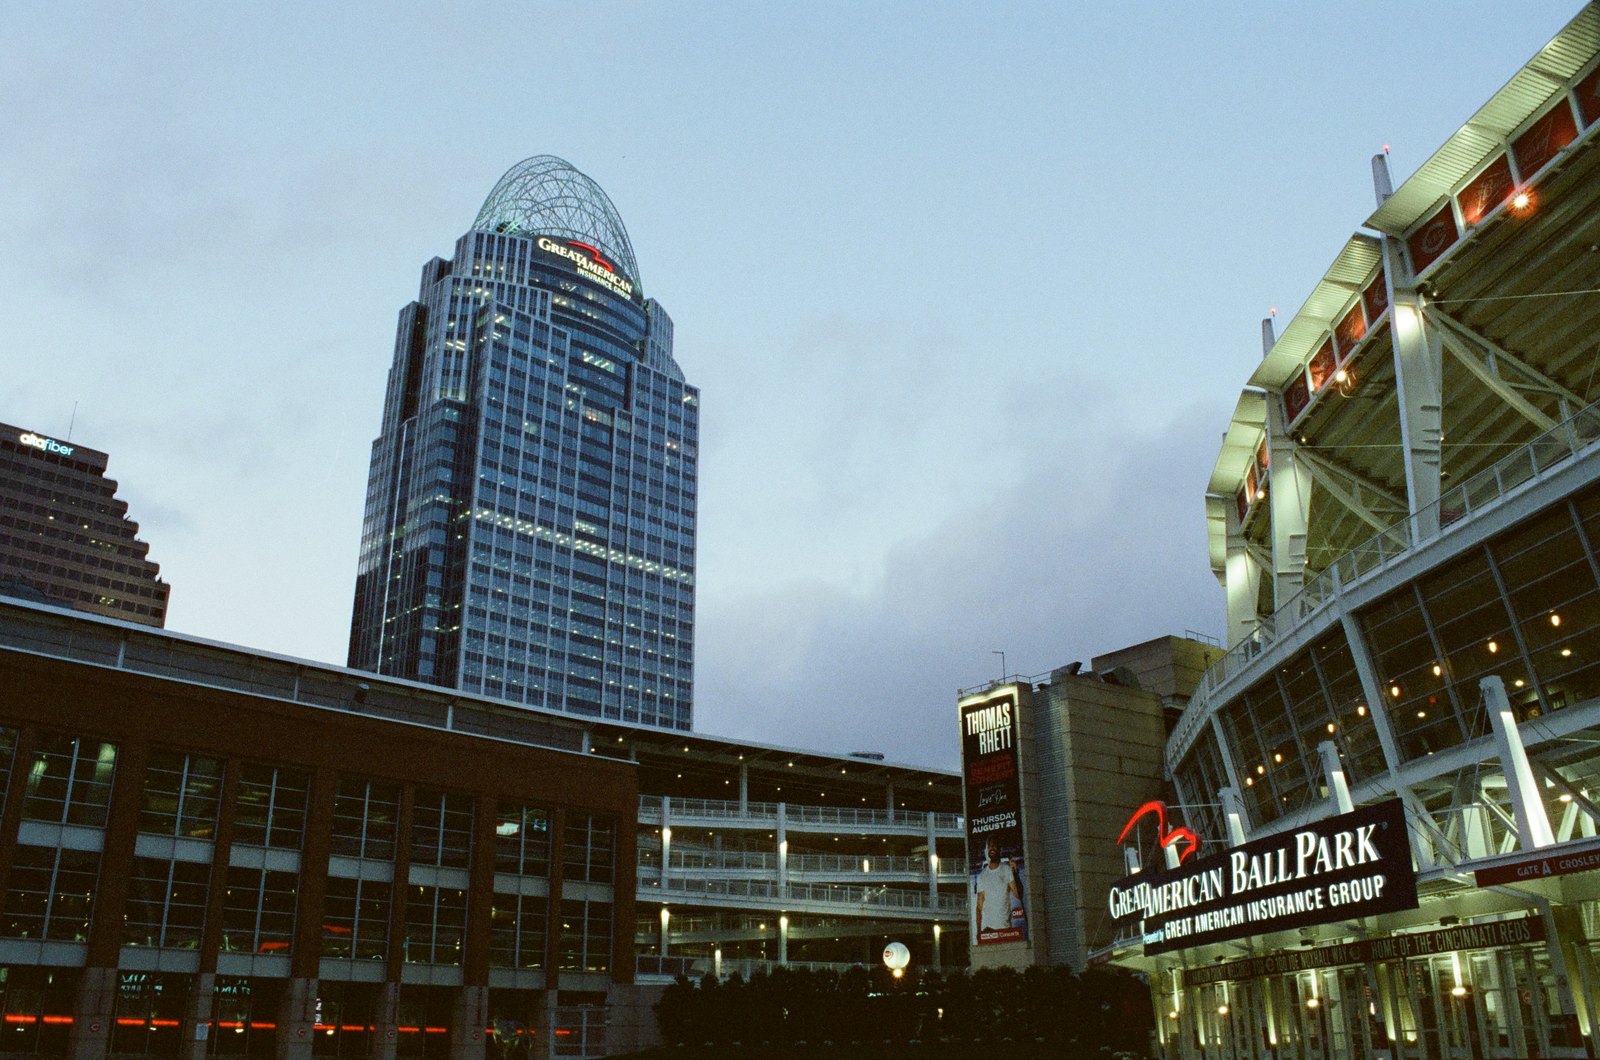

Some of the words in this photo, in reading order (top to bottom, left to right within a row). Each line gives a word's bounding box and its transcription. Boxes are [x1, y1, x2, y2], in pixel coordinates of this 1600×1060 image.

[577, 267, 612, 290] INSURANCE
[965, 702, 1011, 736] THOMAS
[979, 725, 1012, 755] RHETT
[971, 811, 1016, 826] THURSDAY
[972, 821, 1005, 834] AUGUST
[1005, 819, 1017, 828] 29
[1230, 846, 1294, 894] BALL
[1295, 822, 1381, 878] PARK
[1516, 864, 1540, 877] GATE
[1541, 860, 1552, 875] A
[1164, 917, 1192, 940] GREAT
[1194, 905, 1244, 934] AMERICAN
[1247, 887, 1324, 922] INSURANCE
[1329, 875, 1386, 907] GROUP
[1370, 938, 1399, 960] HOME
[1399, 936, 1411, 956] OF
[1413, 934, 1434, 954] THE
[1435, 924, 1497, 951] CINCINNATI
[1499, 920, 1531, 944] REDS
